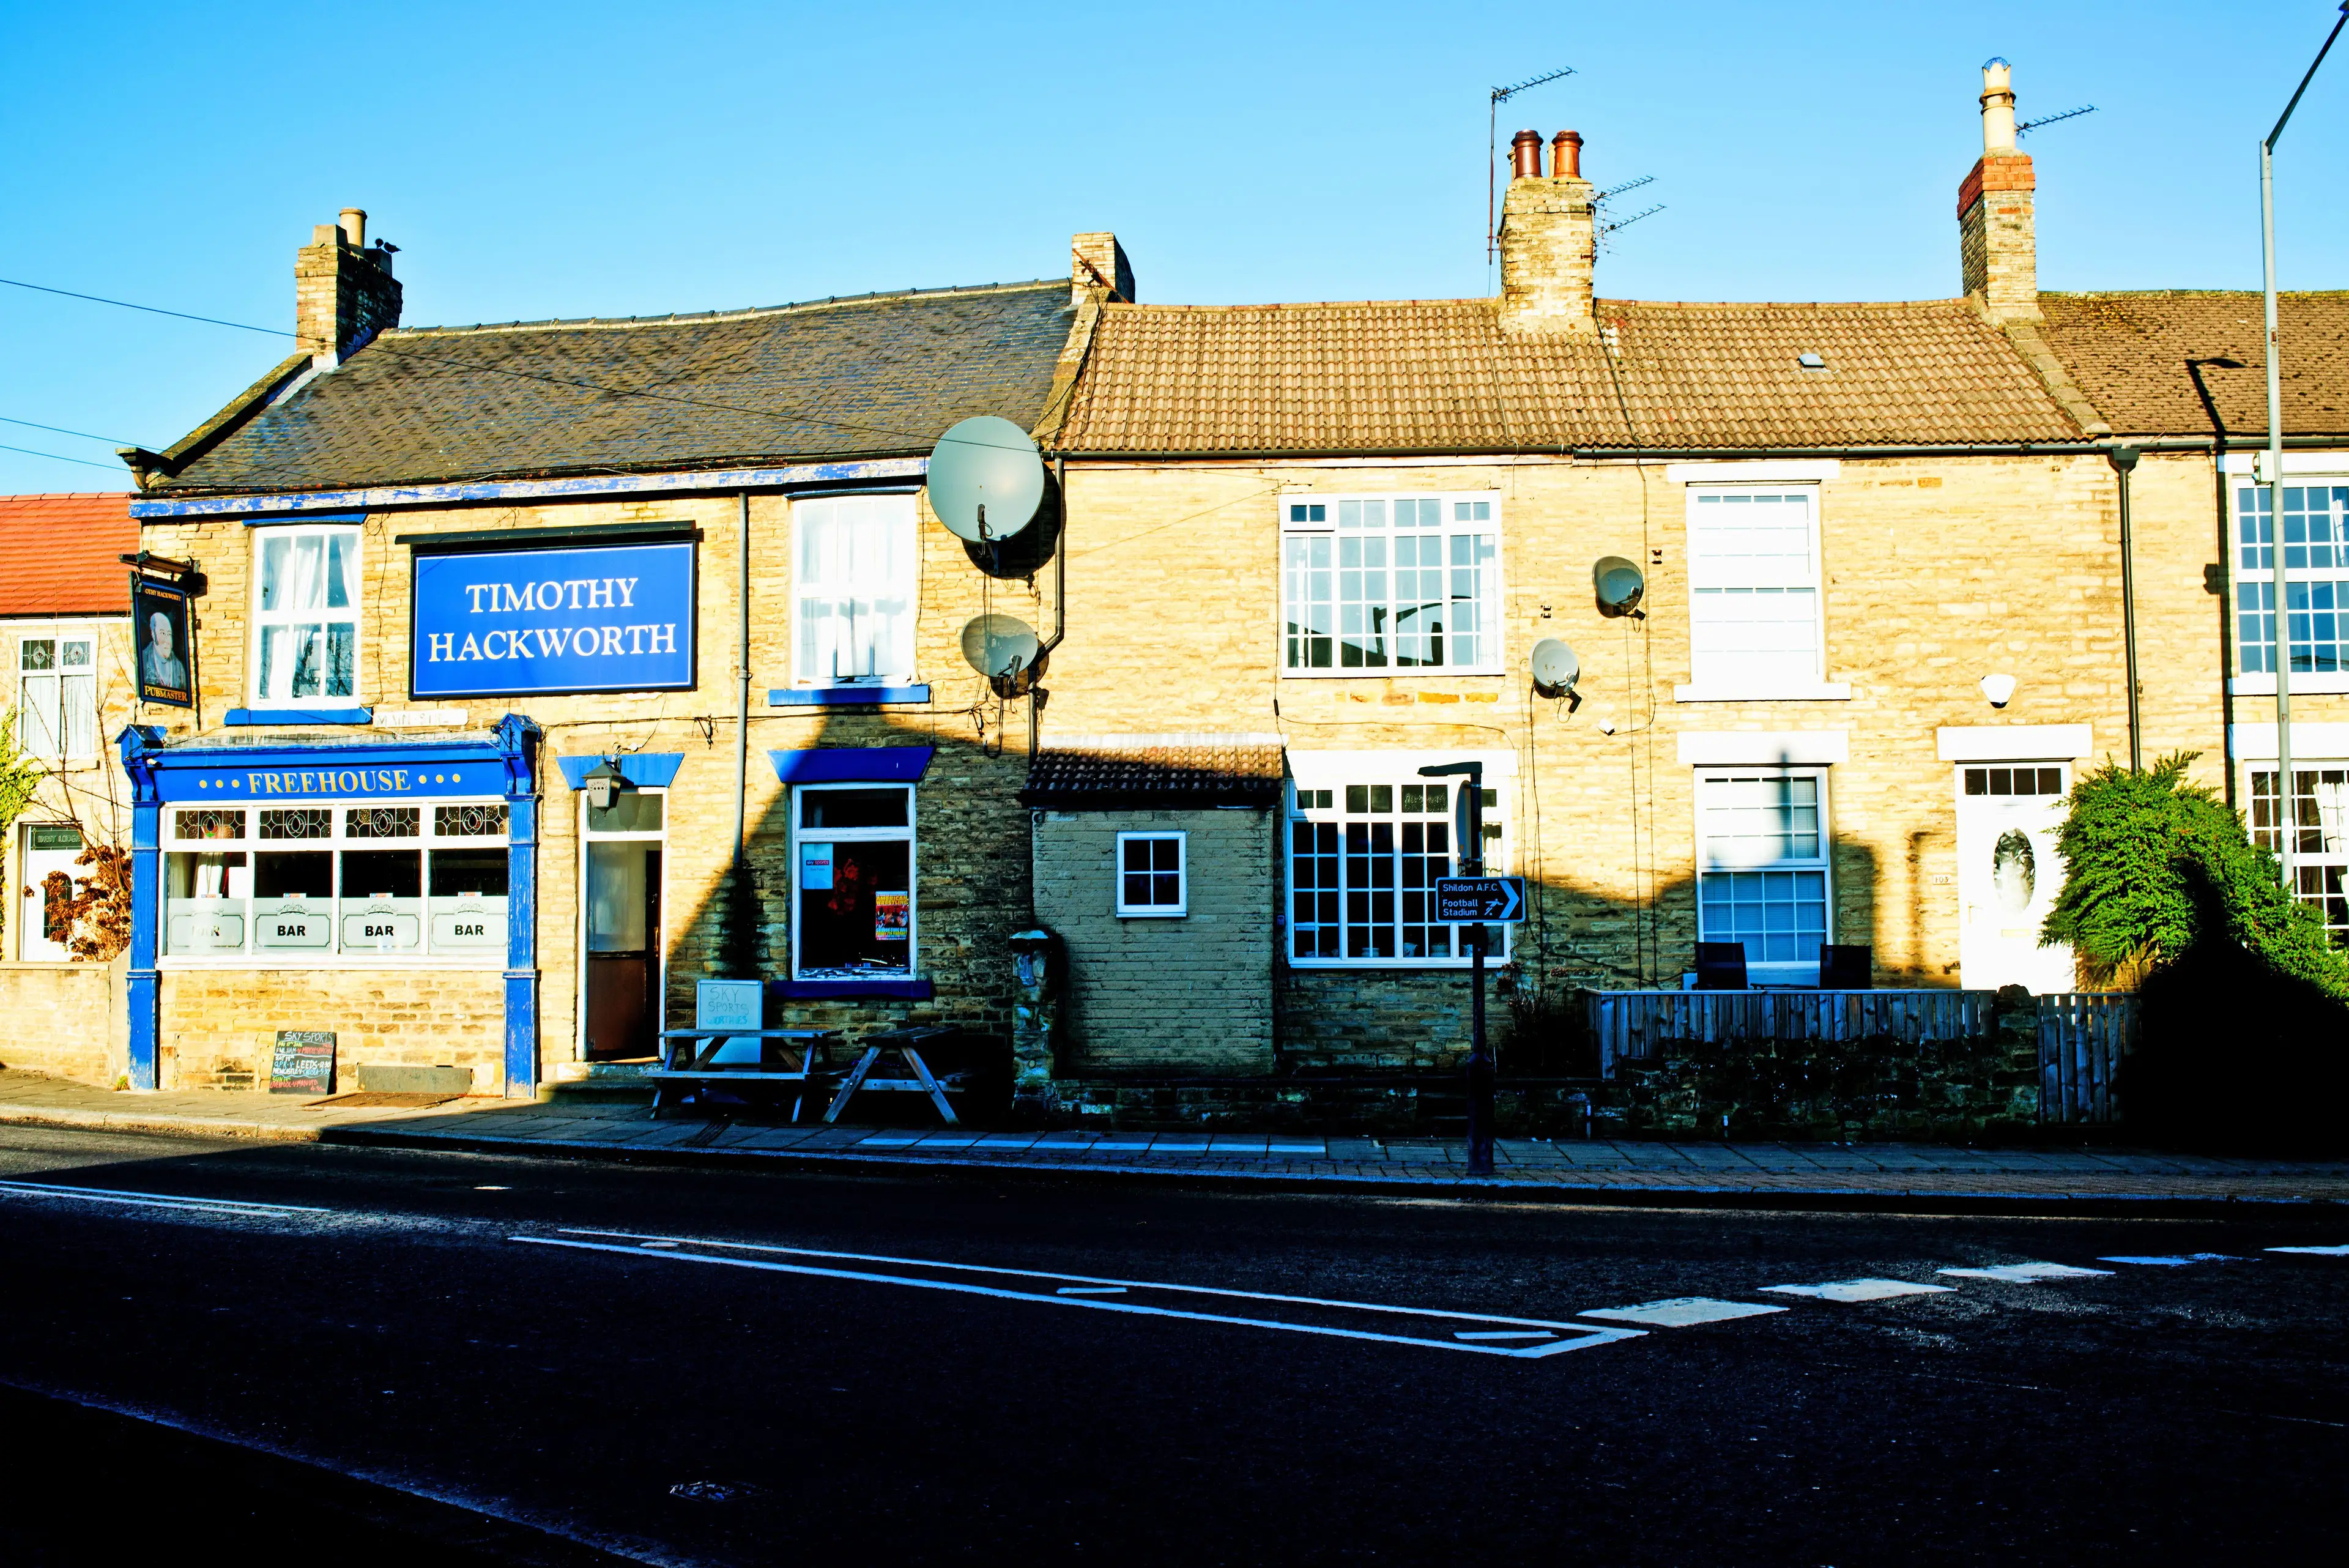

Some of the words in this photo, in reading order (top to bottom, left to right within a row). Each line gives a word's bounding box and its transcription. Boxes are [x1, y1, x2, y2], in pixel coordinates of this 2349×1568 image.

[466, 577, 638, 613] TIMOTHY
[428, 623, 677, 663] HACKWORTH
[144, 686, 187, 702] PUBMASTER
[247, 770, 411, 793] FREEHOUSE
[1442, 883, 1473, 892] Shildon
[1477, 883, 1499, 892] A.F.C.
[277, 925, 306, 937] BAR
[365, 925, 394, 937] BAR
[455, 924, 484, 935] BAR
[710, 987, 739, 1003] SKY
[708, 1001, 749, 1015] SPORTS
[284, 1031, 303, 1041] SKY
[303, 1032, 332, 1043] SPORTS
[296, 1060, 317, 1069] LEEDS
